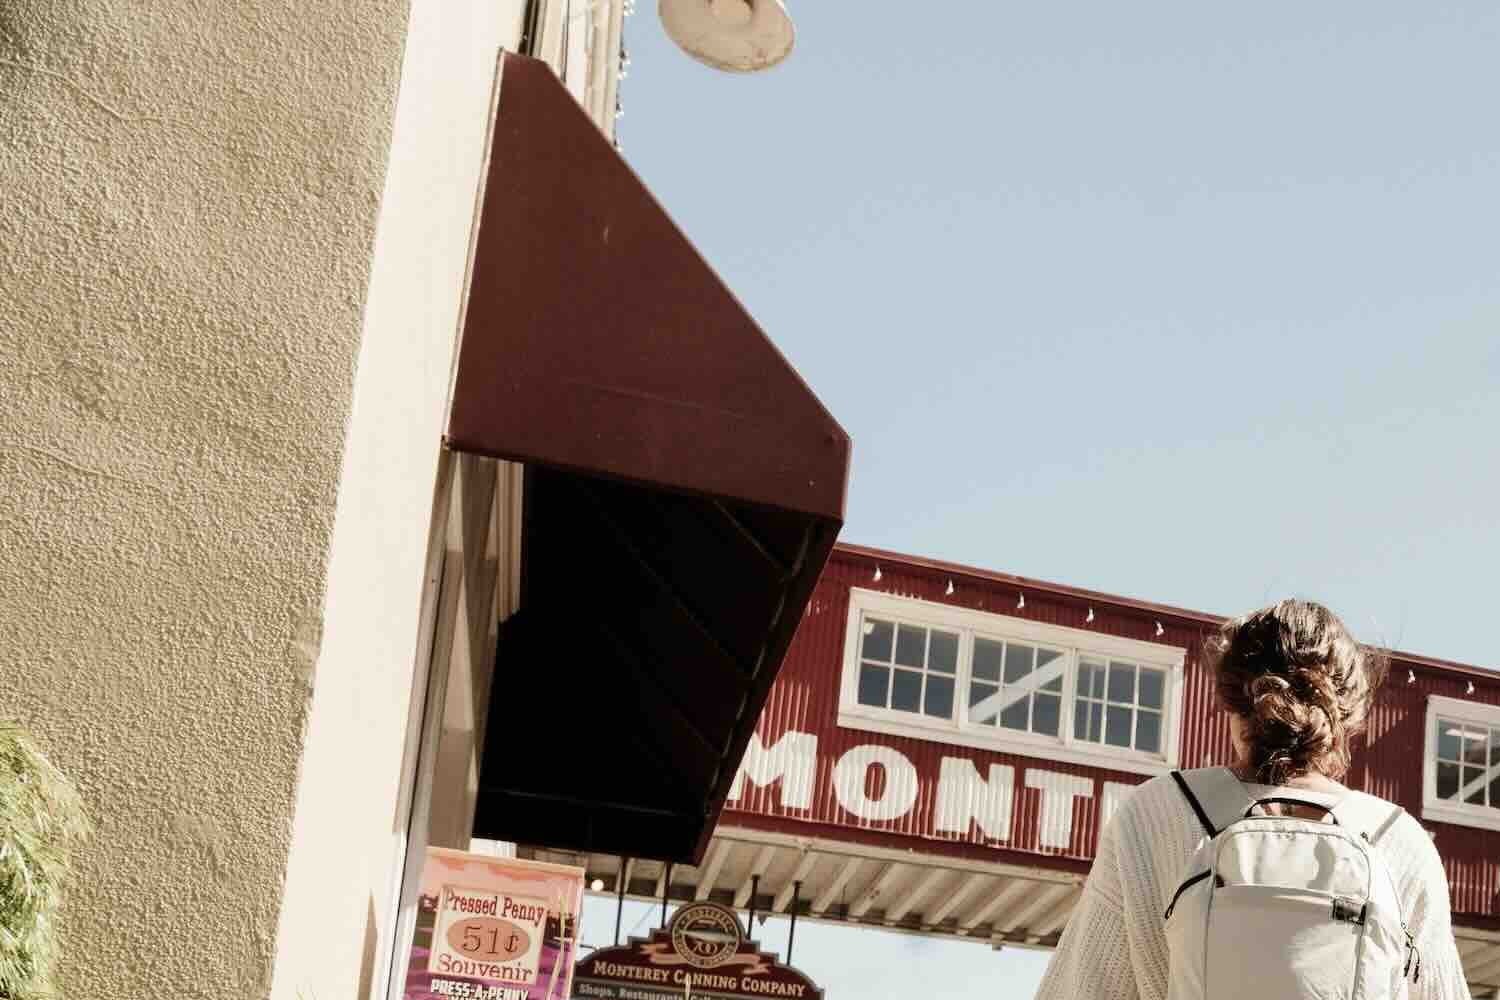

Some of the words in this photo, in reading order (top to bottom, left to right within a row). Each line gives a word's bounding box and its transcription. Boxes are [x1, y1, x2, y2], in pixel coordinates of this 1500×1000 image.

[728, 730, 1149, 850] MONT
[442, 886, 499, 916] Pressed
[502, 896, 546, 928] Penny
[438, 952, 534, 982] Souvenir
[593, 960, 670, 982] MONTEREY
[673, 969, 738, 990] CANNING
[741, 976, 806, 997] COMPANY
